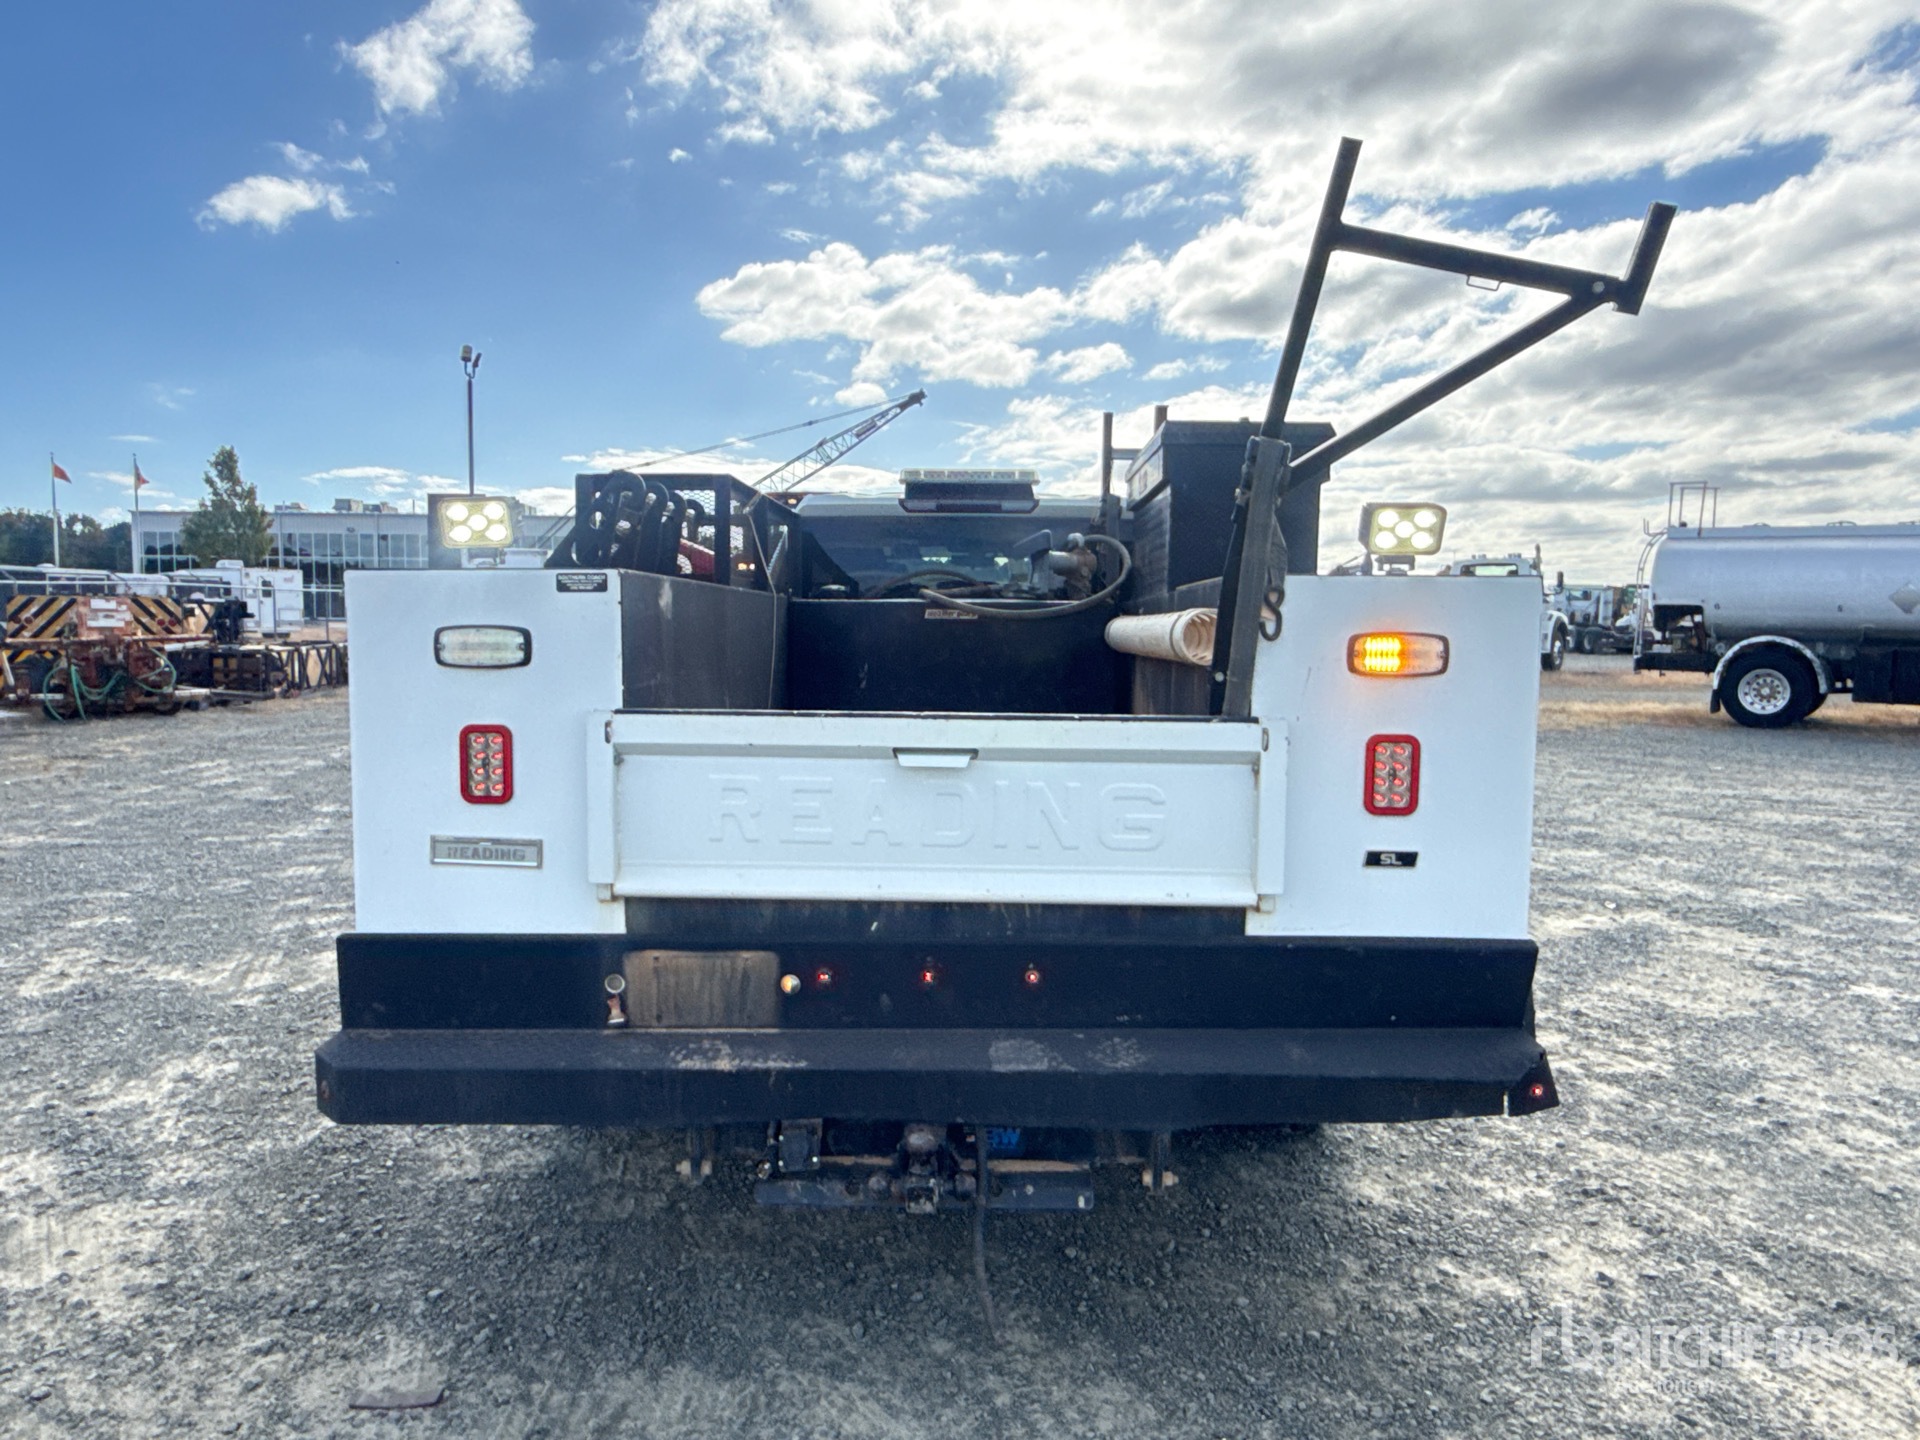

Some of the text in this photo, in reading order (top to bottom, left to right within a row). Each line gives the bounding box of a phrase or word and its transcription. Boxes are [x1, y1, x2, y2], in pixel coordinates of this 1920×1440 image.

[708, 774, 1166, 852] READING
[447, 846, 526, 861] READING
[1379, 852, 1403, 866] SL
